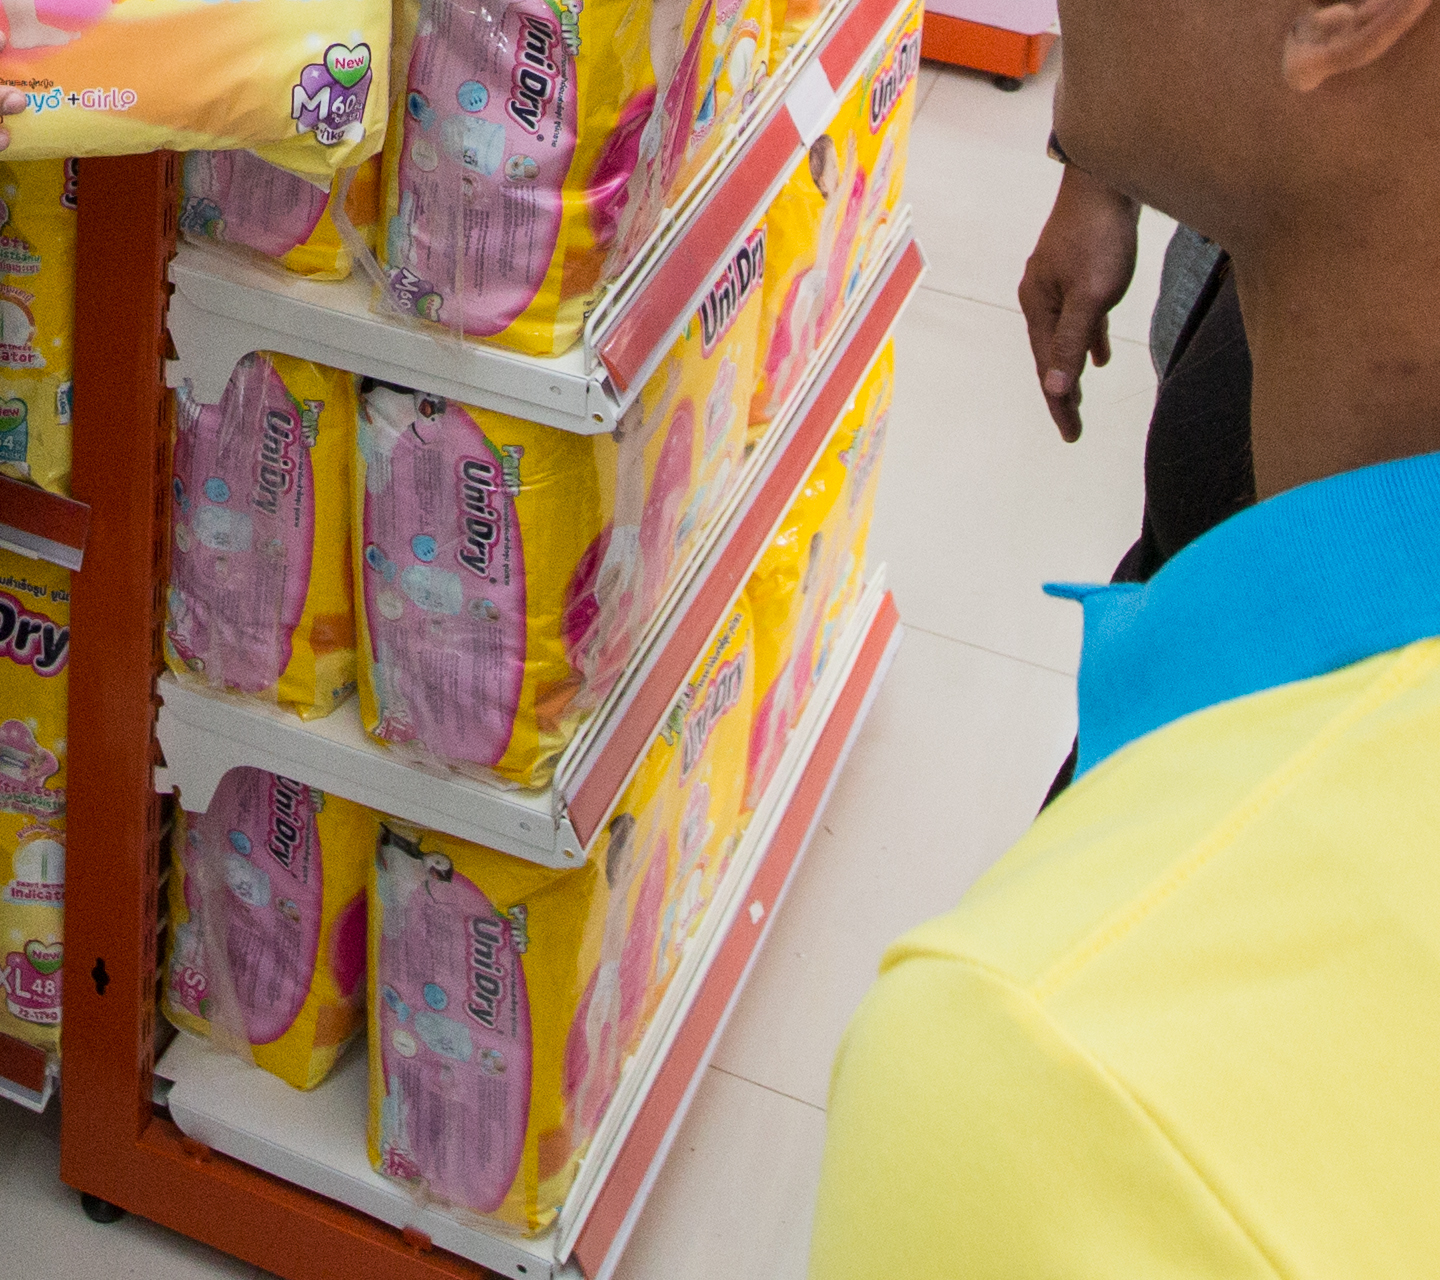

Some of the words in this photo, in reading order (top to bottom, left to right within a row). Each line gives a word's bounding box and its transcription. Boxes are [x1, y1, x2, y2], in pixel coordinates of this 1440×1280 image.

[291, 84, 332, 120] M
[331, 93, 358, 116] 60
[334, 55, 365, 70] New
[512, 14, 558, 134] UniDry
[699, 235, 769, 350] UniDry
[255, 410, 296, 516] UniDry
[458, 458, 499, 580] UniDry
[31, 978, 57, 995] 48
[32, 947, 60, 963] New
[462, 914, 507, 1031] UniDry
